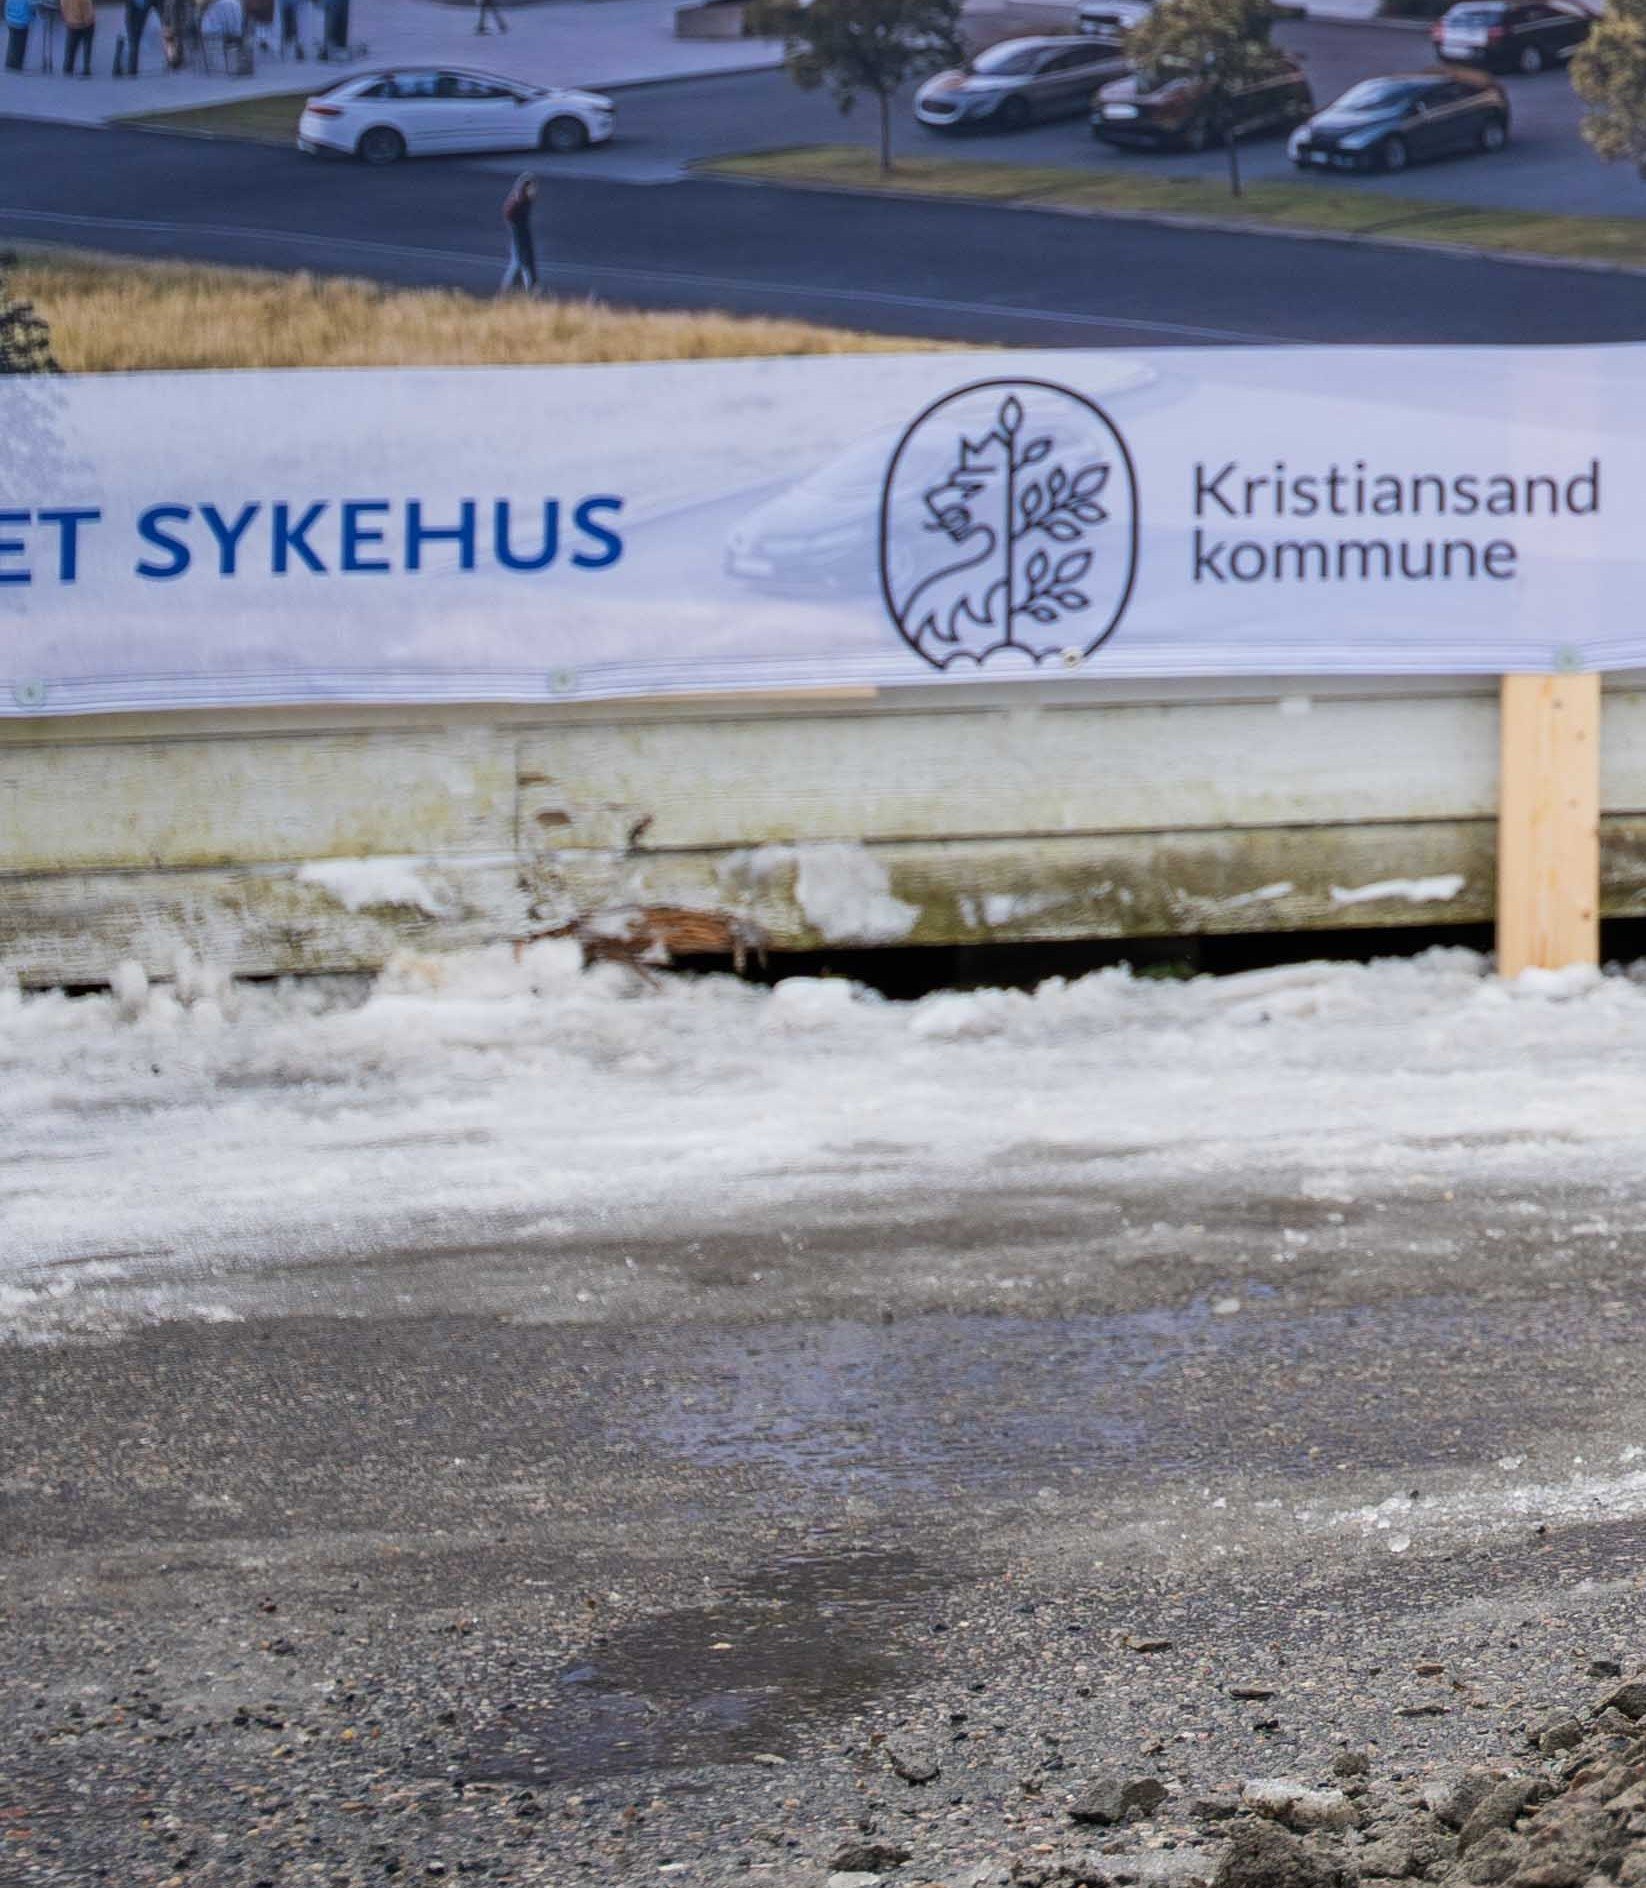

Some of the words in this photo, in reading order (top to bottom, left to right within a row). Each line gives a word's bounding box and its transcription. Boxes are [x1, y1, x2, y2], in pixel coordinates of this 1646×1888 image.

[1193, 458, 1600, 517] Kristiansand
[135, 495, 625, 581] SYKEHUS
[1192, 528, 1518, 583] kommune
